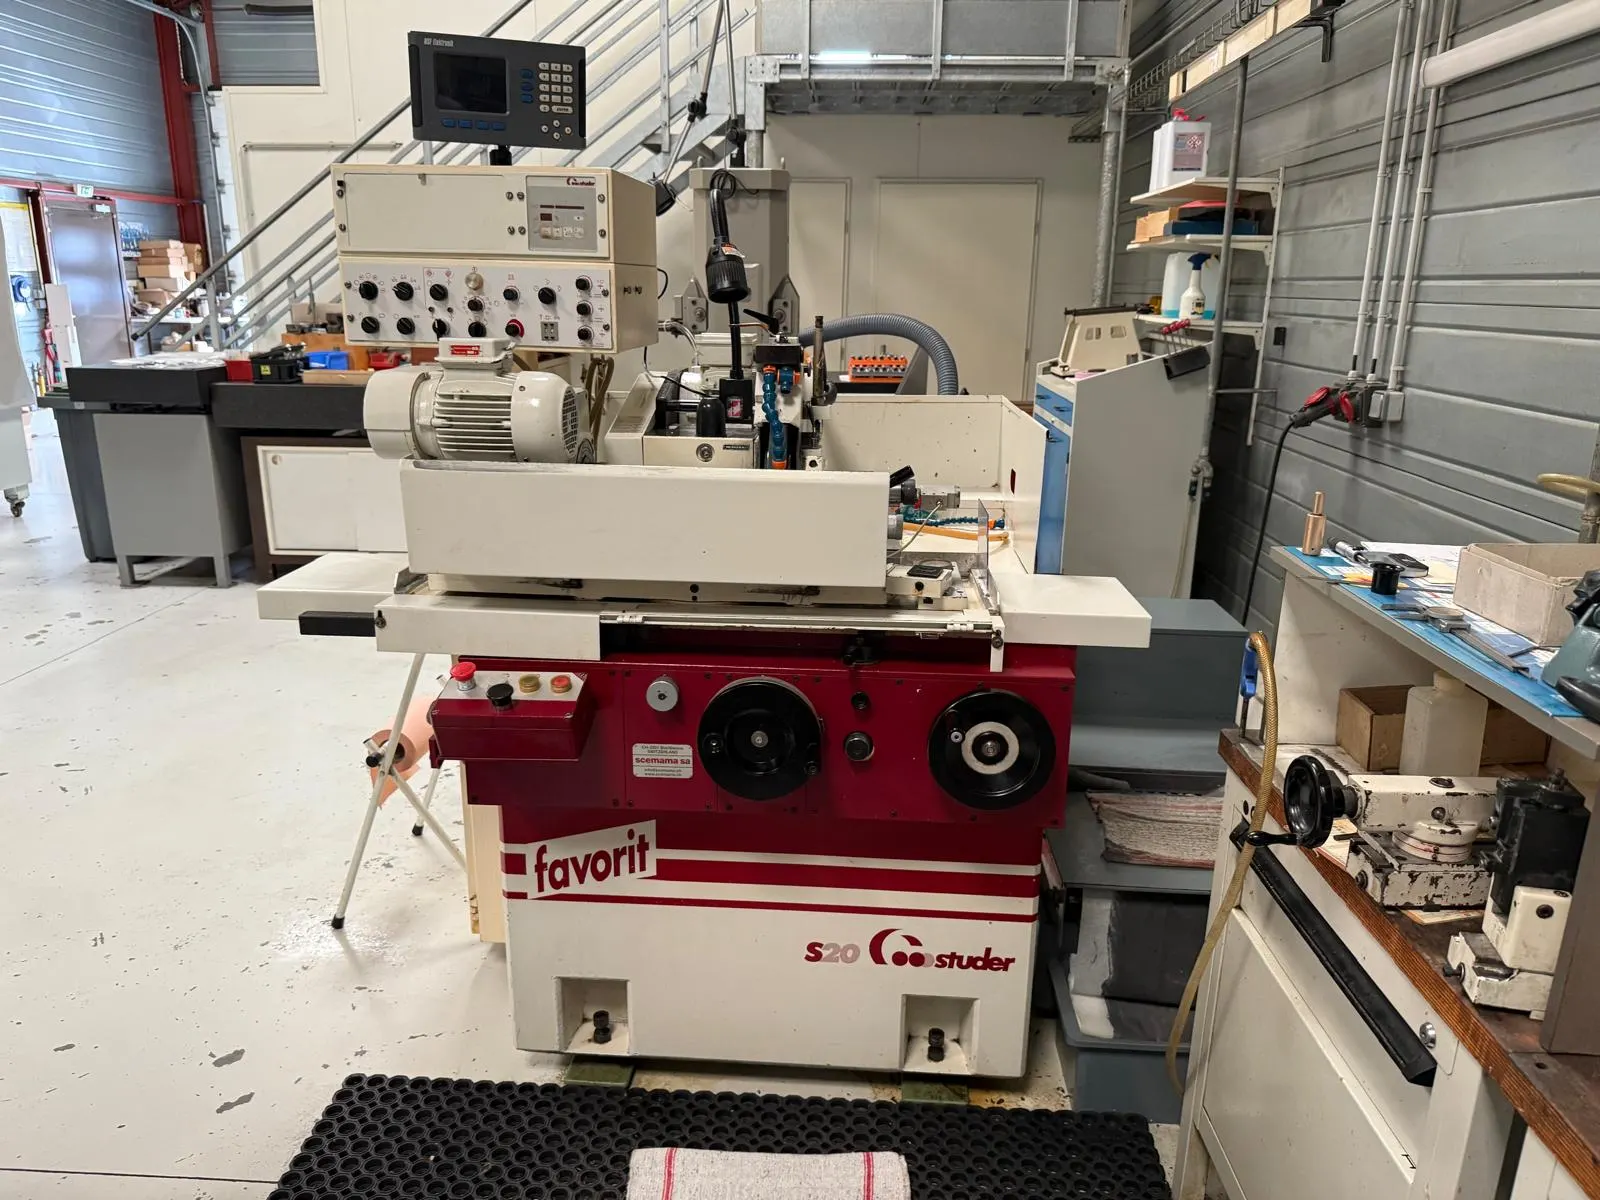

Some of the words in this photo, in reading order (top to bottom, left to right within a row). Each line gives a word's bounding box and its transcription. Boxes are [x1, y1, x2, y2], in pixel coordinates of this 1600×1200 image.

[534, 828, 650, 893] favorit
[804, 941, 861, 964] S20
[934, 947, 1016, 972] studer
